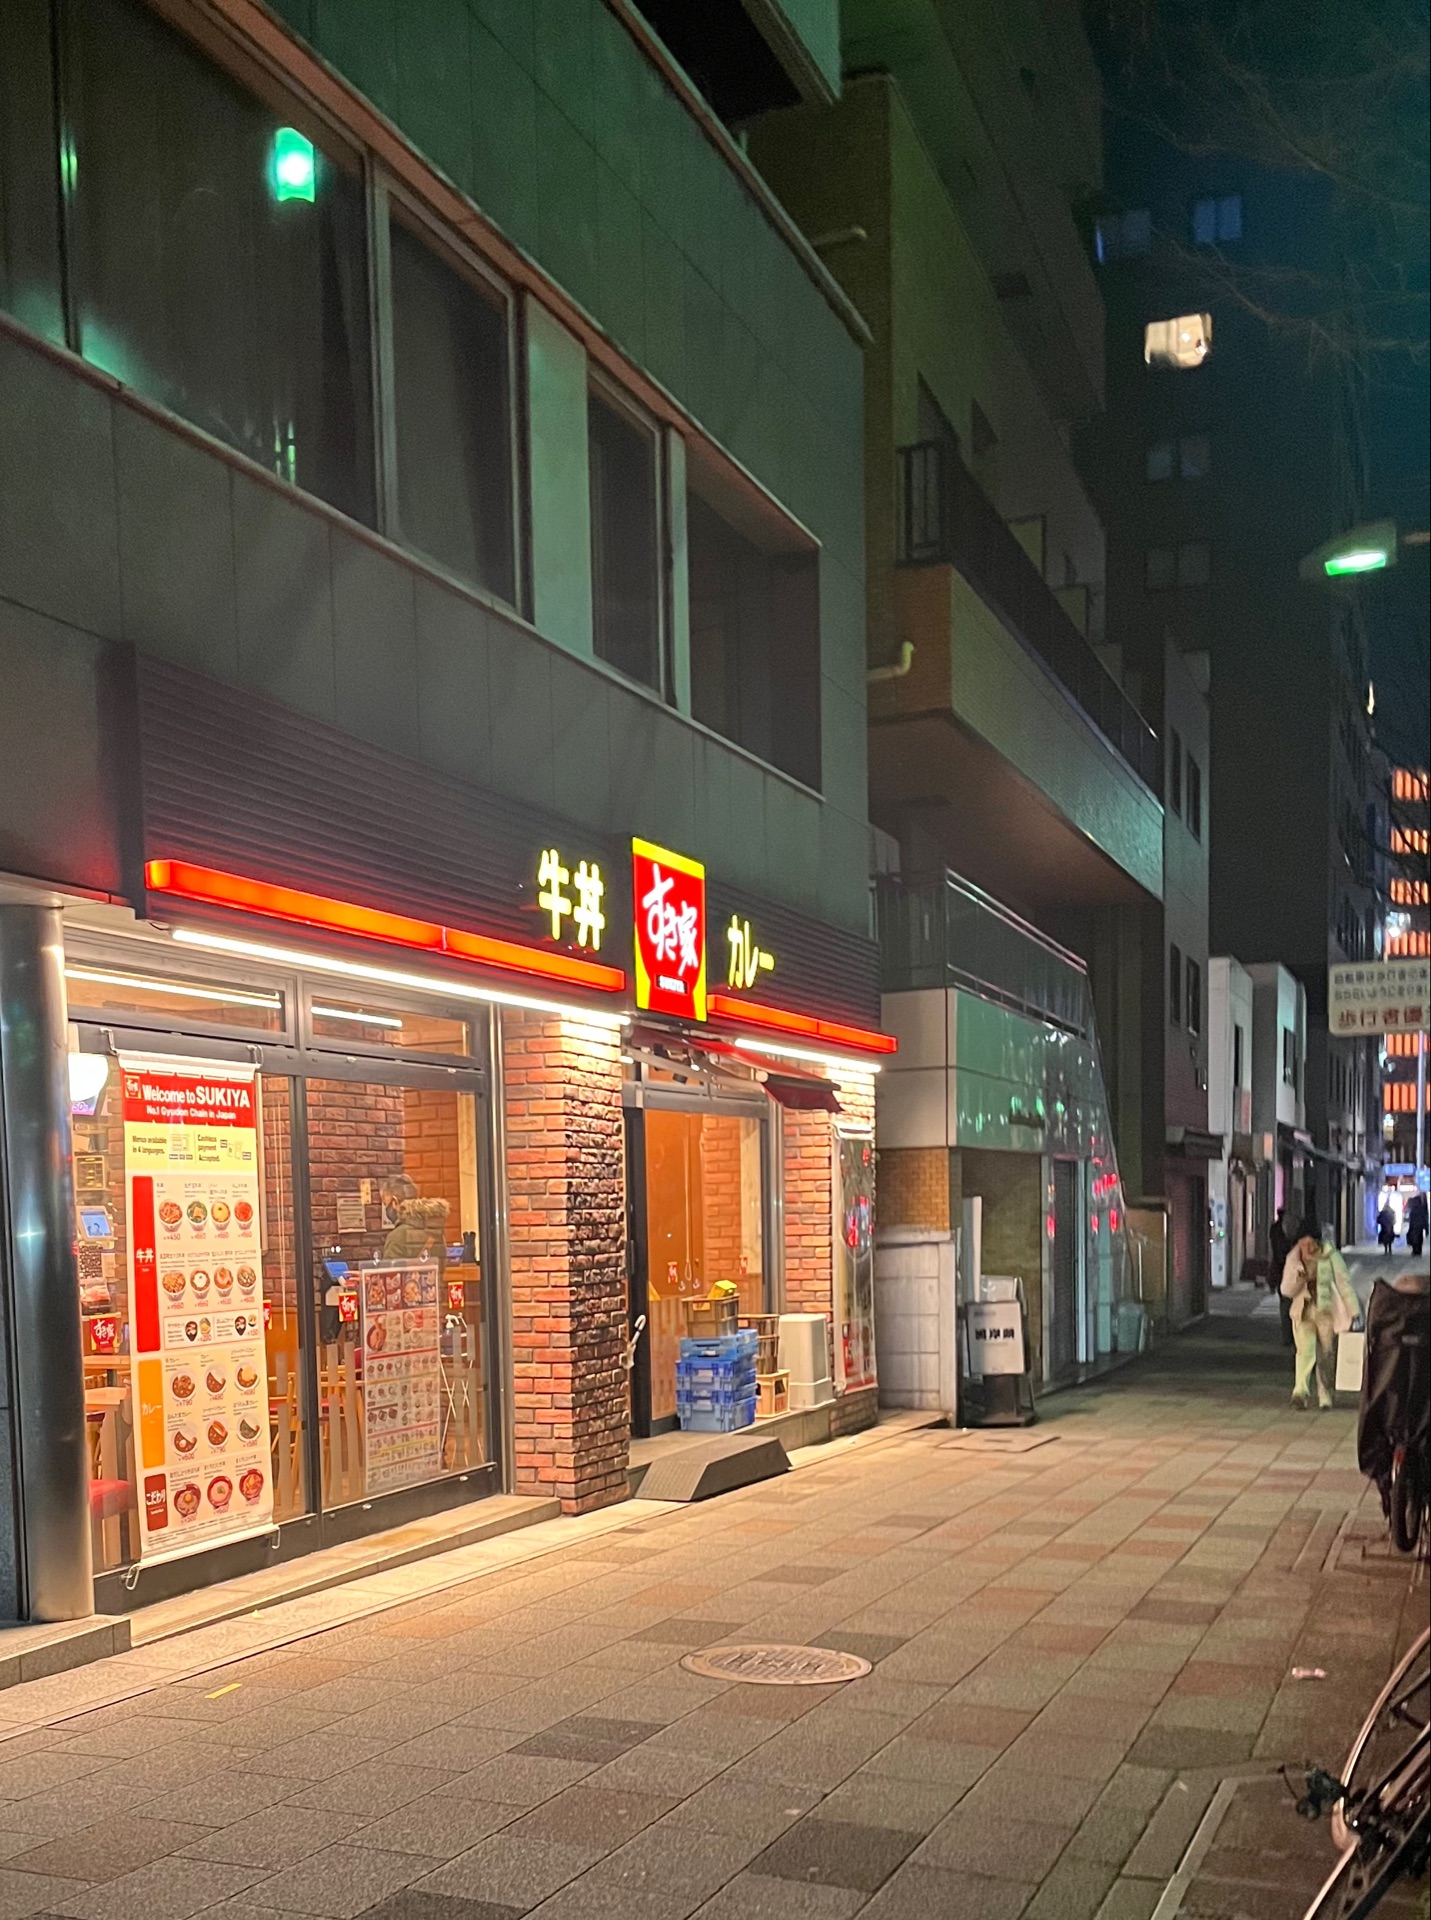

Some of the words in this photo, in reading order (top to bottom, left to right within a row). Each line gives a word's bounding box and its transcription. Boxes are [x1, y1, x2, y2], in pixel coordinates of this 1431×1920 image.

[537, 848, 605, 951] 牛丼
[642, 863, 699, 976] すき家
[727, 914, 775, 988] カレー
[1339, 1006, 1429, 1028] 歩行者優
[142, 1084, 185, 1103] Welcome
[186, 1089, 196, 1104] to
[195, 1086, 250, 1108] SUKIYA
[146, 1105, 160, 1115] No.1
[161, 1106, 188, 1116] Gyudon
[190, 1108, 208, 1118] Chain
[216, 1110, 236, 1120] Japan
[136, 1248, 154, 1263] 牛丼
[95, 1319, 115, 1339] すき家
[142, 1402, 162, 1416] カレー
[145, 1488, 166, 1505] こだわり
